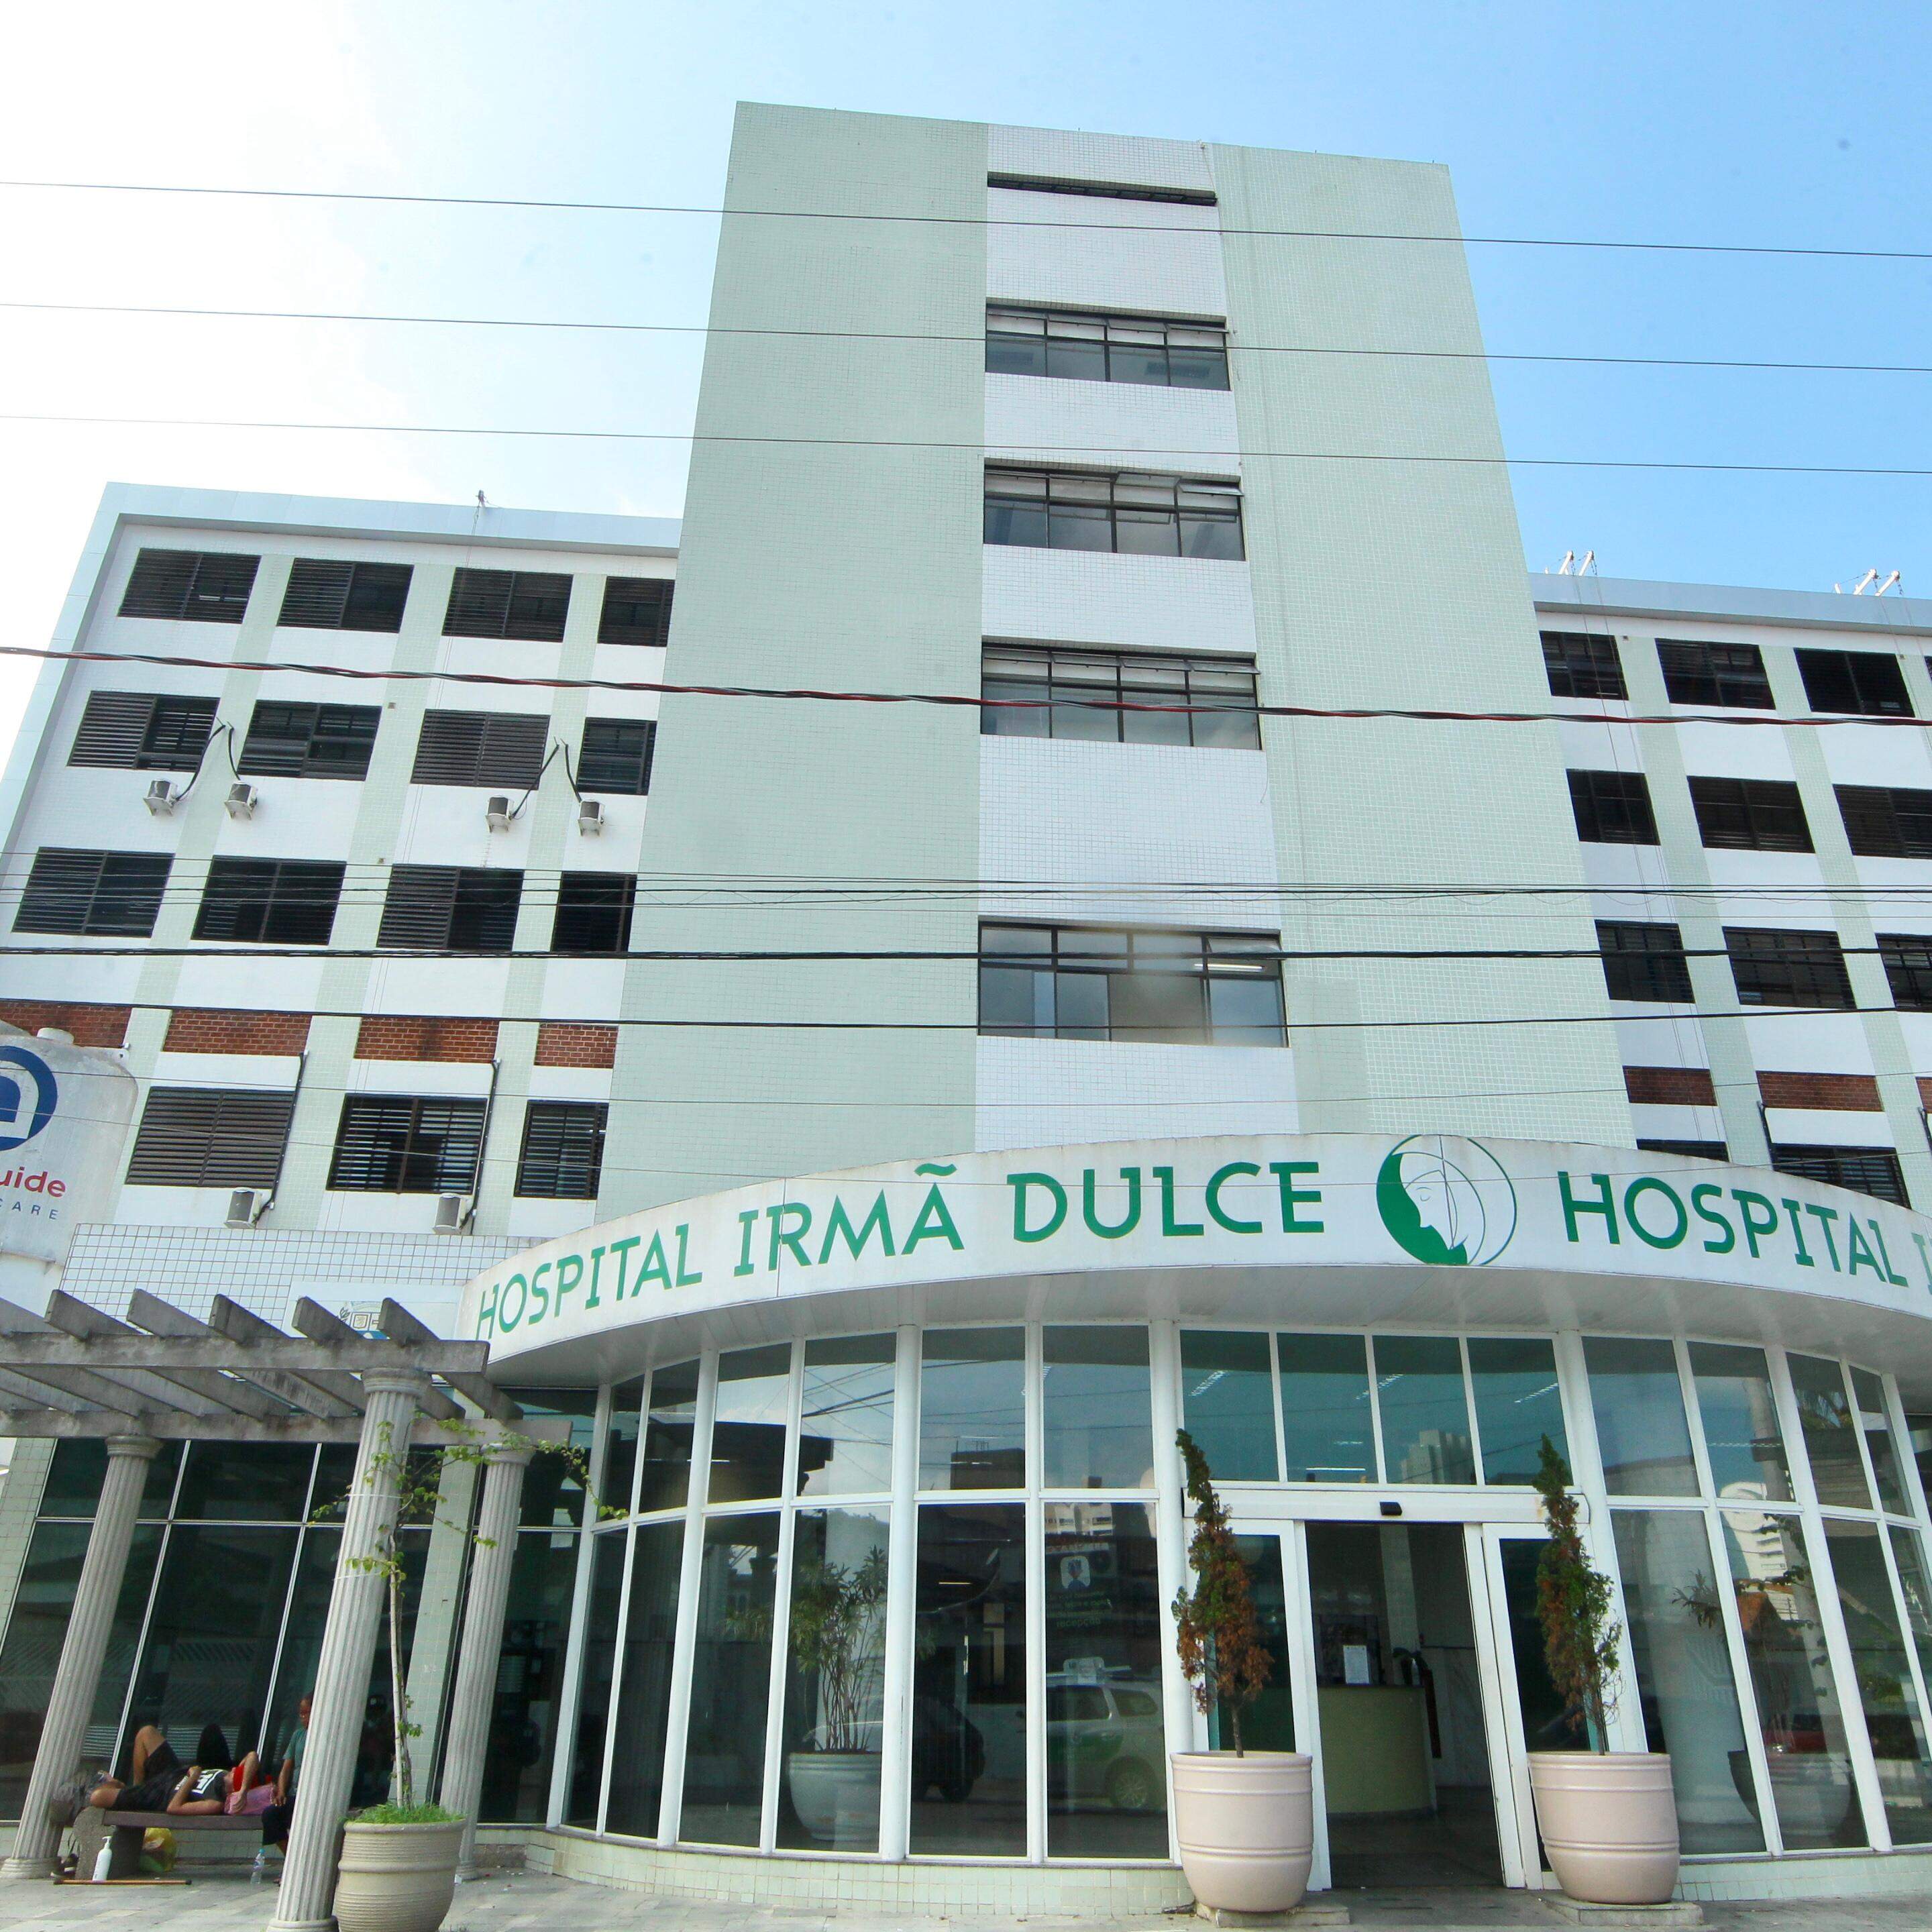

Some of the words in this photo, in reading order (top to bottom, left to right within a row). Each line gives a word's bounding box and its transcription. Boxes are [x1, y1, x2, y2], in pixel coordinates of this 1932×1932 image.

[476, 1223, 702, 1340] HOSPITAL
[734, 1163, 965, 1277] IRMÃ
[1006, 1161, 1324, 1243] DULCE
[1557, 1171, 1909, 1287] HOSPITAL
